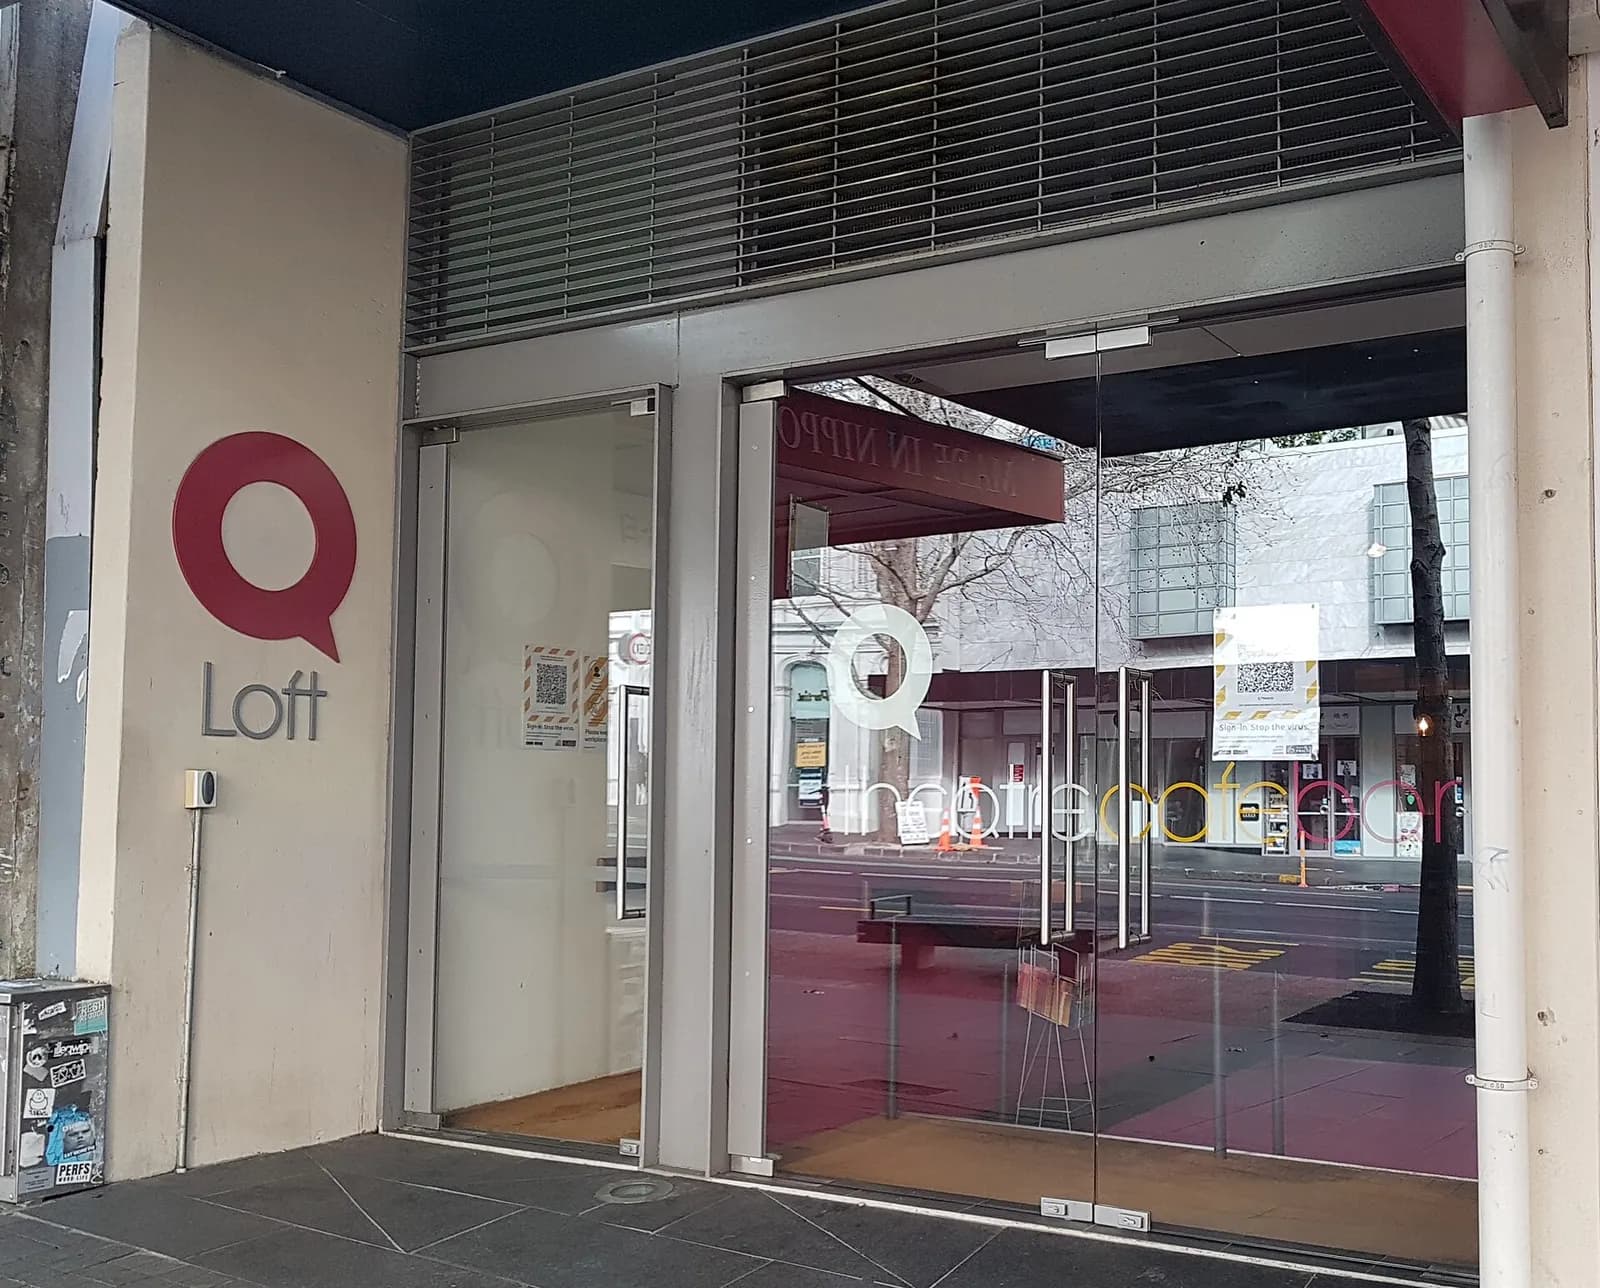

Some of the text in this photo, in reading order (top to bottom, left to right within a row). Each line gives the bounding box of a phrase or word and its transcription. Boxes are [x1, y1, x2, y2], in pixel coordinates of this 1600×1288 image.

[172, 431, 357, 663] Q
[202, 661, 328, 740] Loft
[829, 604, 933, 741] Q
[1250, 723, 1270, 732] Stop
[1271, 722, 1286, 731] the
[1293, 758, 1463, 844] bar
[58, 1163, 91, 1177] PERFS
